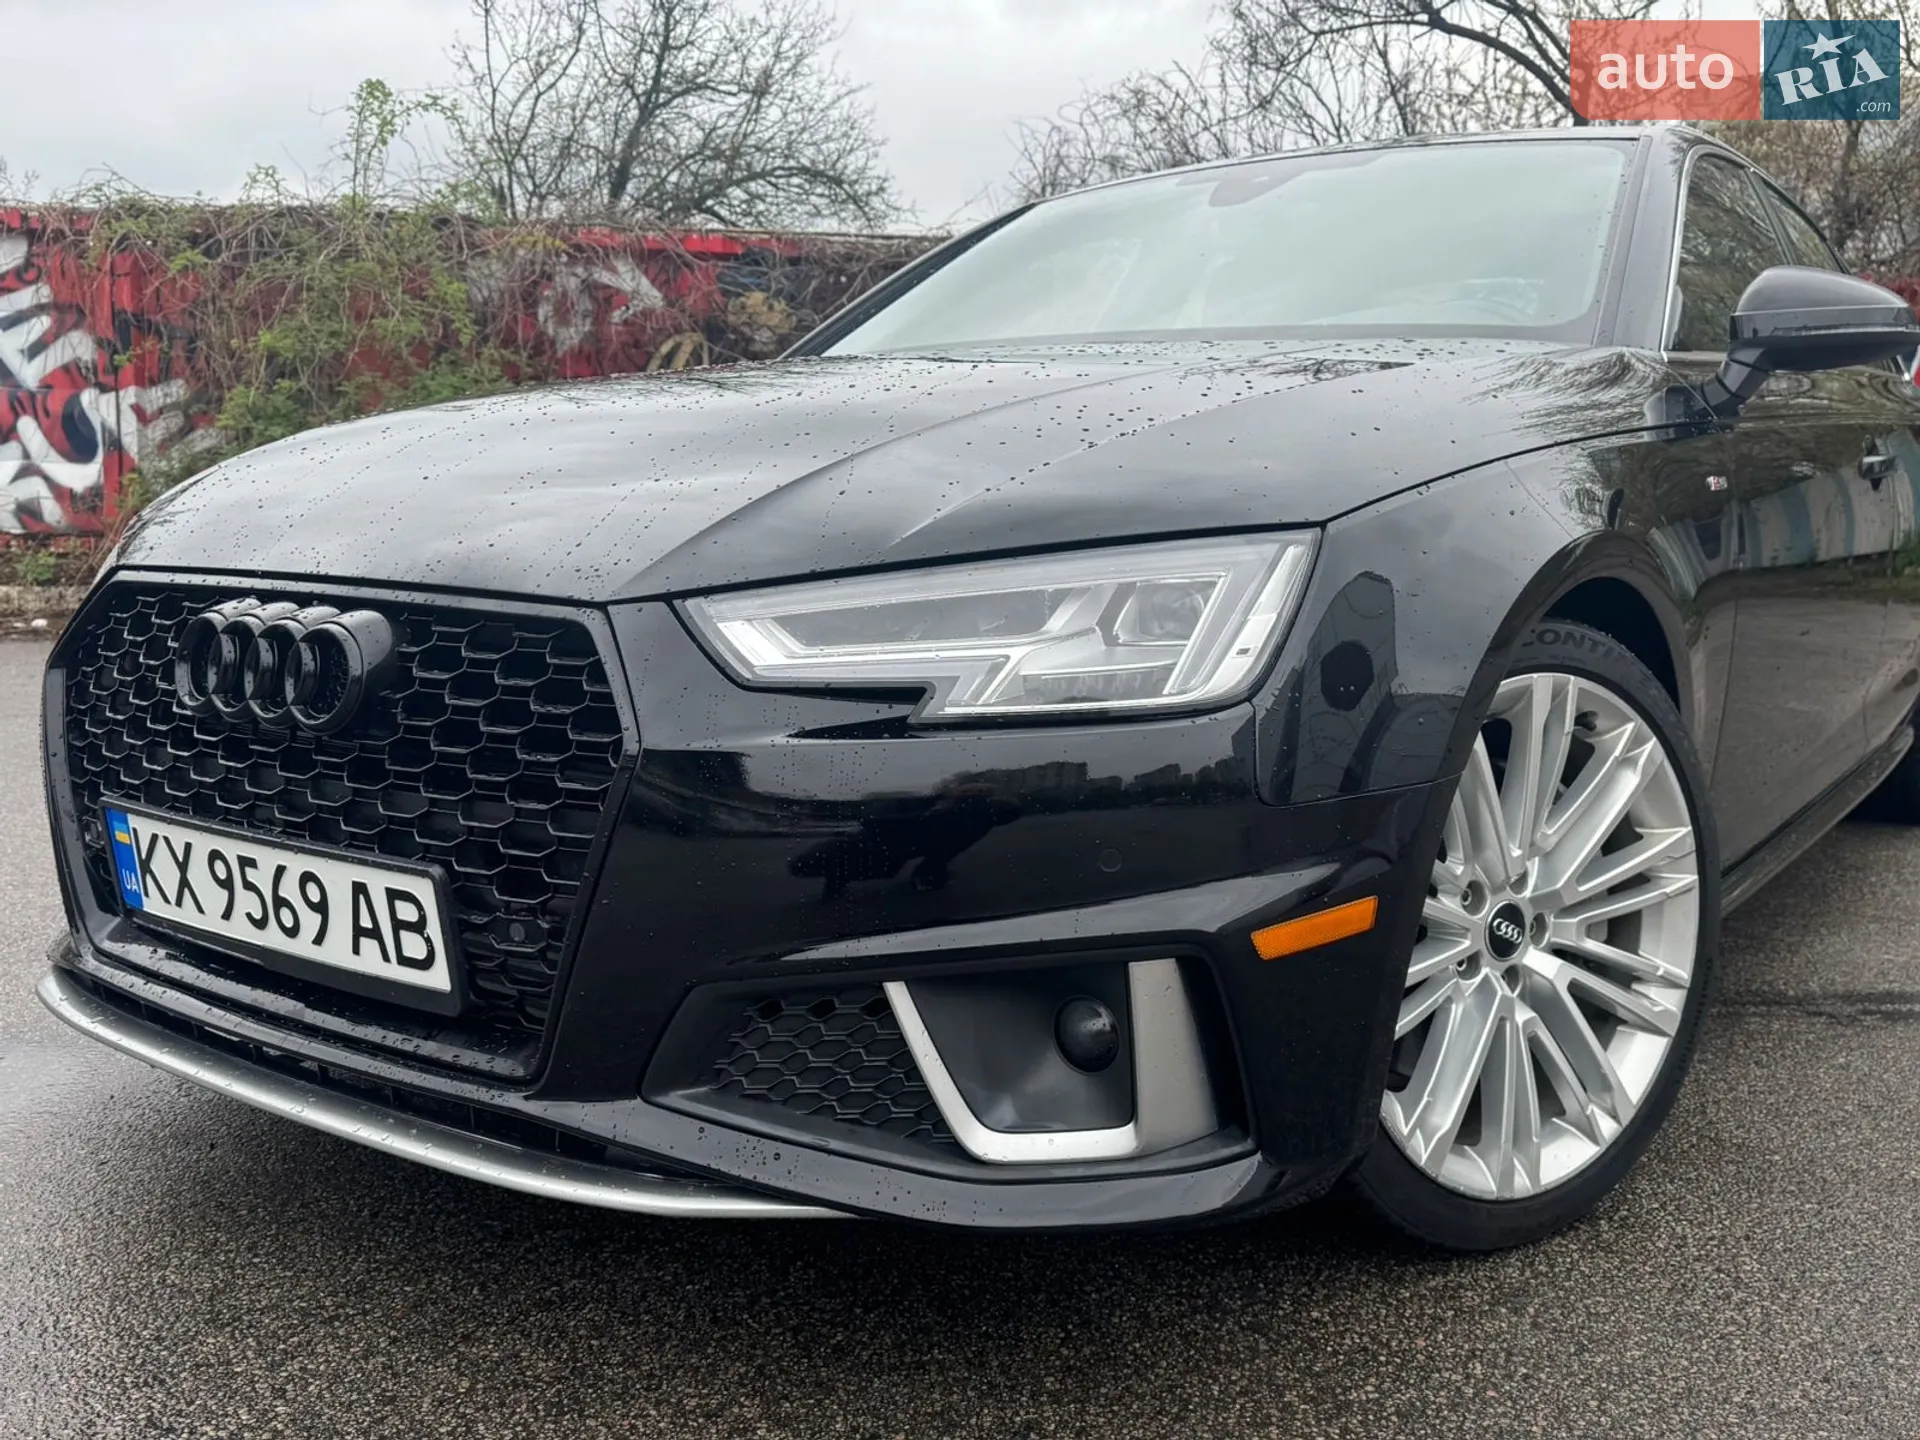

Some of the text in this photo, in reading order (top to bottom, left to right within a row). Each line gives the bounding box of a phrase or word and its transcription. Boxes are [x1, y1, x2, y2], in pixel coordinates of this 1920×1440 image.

[122, 868, 139, 894] UA
[131, 826, 436, 972] KX 9569 AB
